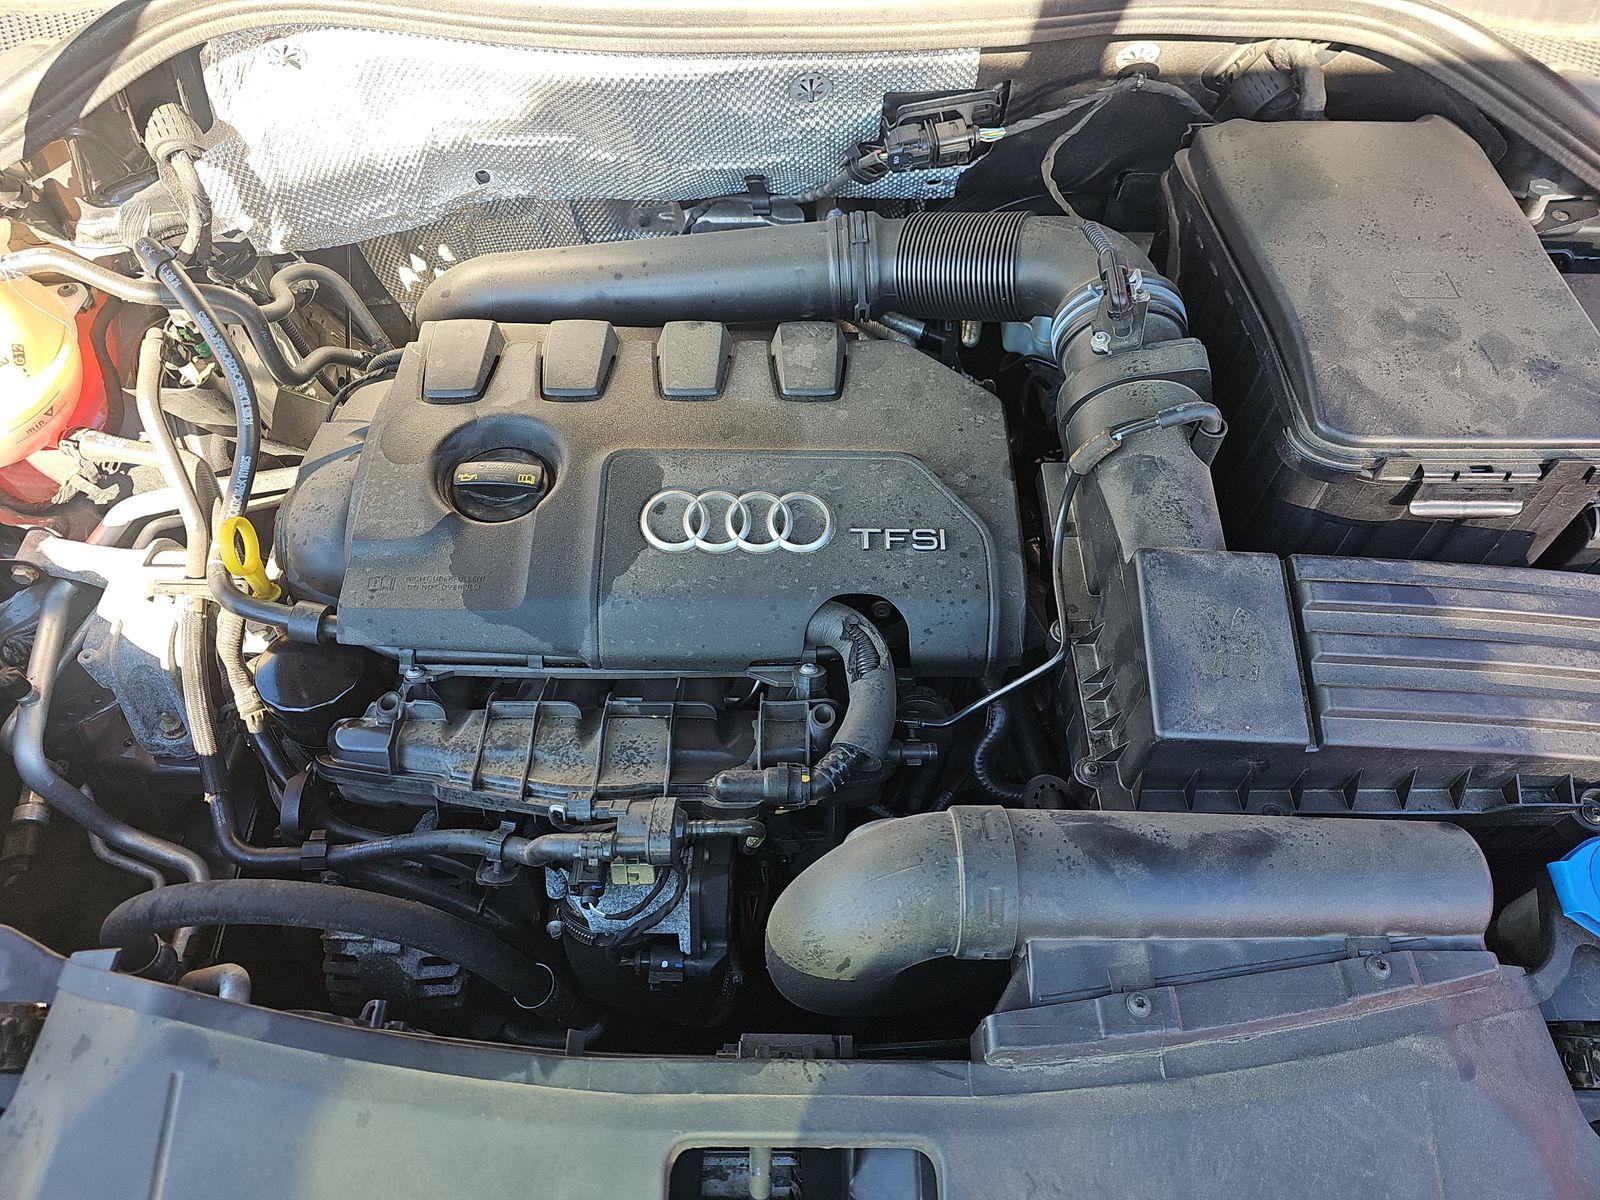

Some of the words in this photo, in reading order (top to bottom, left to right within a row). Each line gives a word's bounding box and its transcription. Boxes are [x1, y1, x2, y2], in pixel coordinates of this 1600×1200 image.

[12, 344, 26, 366] G12
[26, 420, 45, 435] min
[850, 528, 946, 551] TFSI
